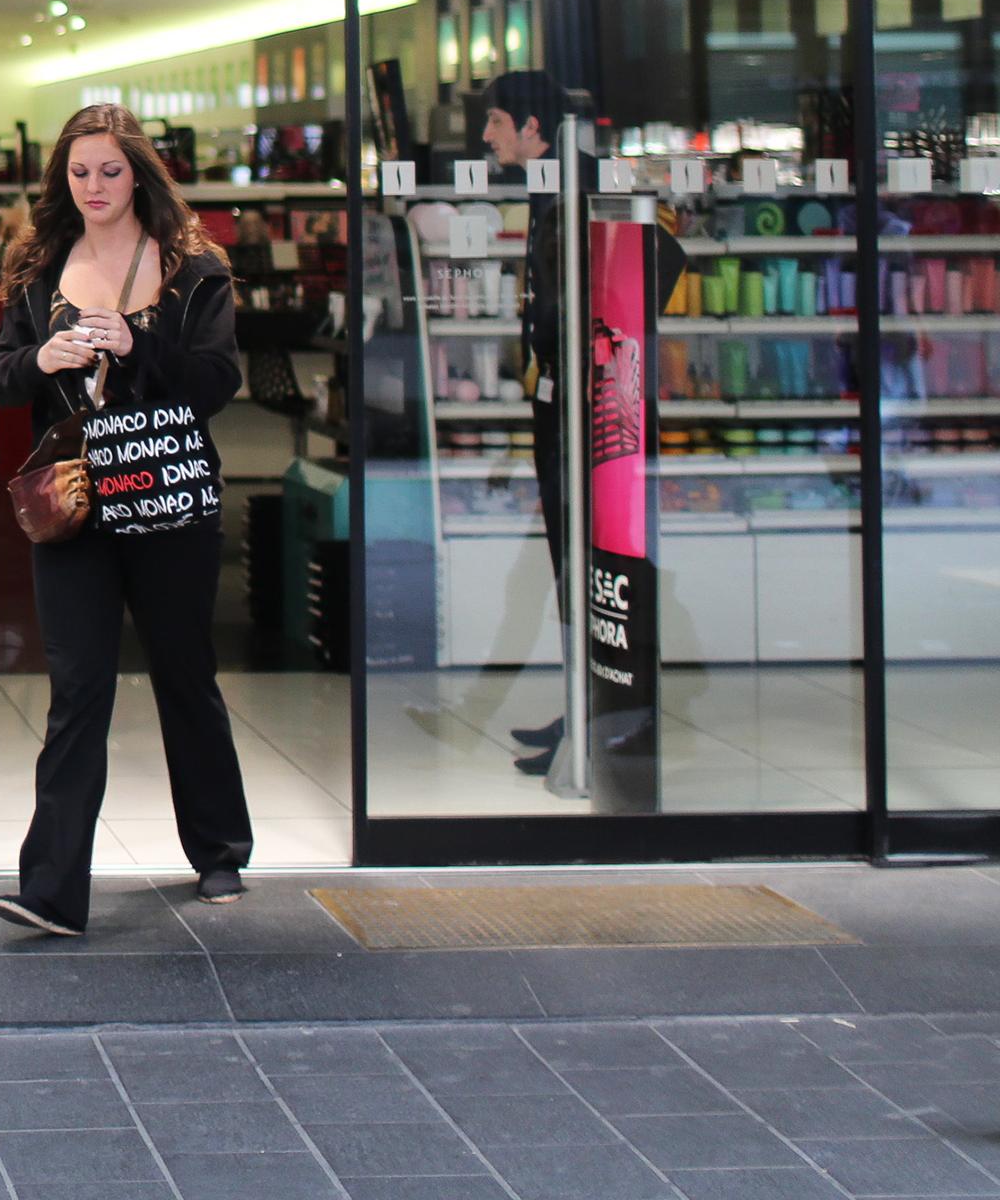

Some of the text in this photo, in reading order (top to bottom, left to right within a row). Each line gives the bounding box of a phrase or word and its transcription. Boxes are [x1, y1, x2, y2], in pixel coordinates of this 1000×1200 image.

[437, 268, 484, 279] SEPHO
[87, 412, 148, 440] MONACO
[98, 471, 154, 496] MONACO
